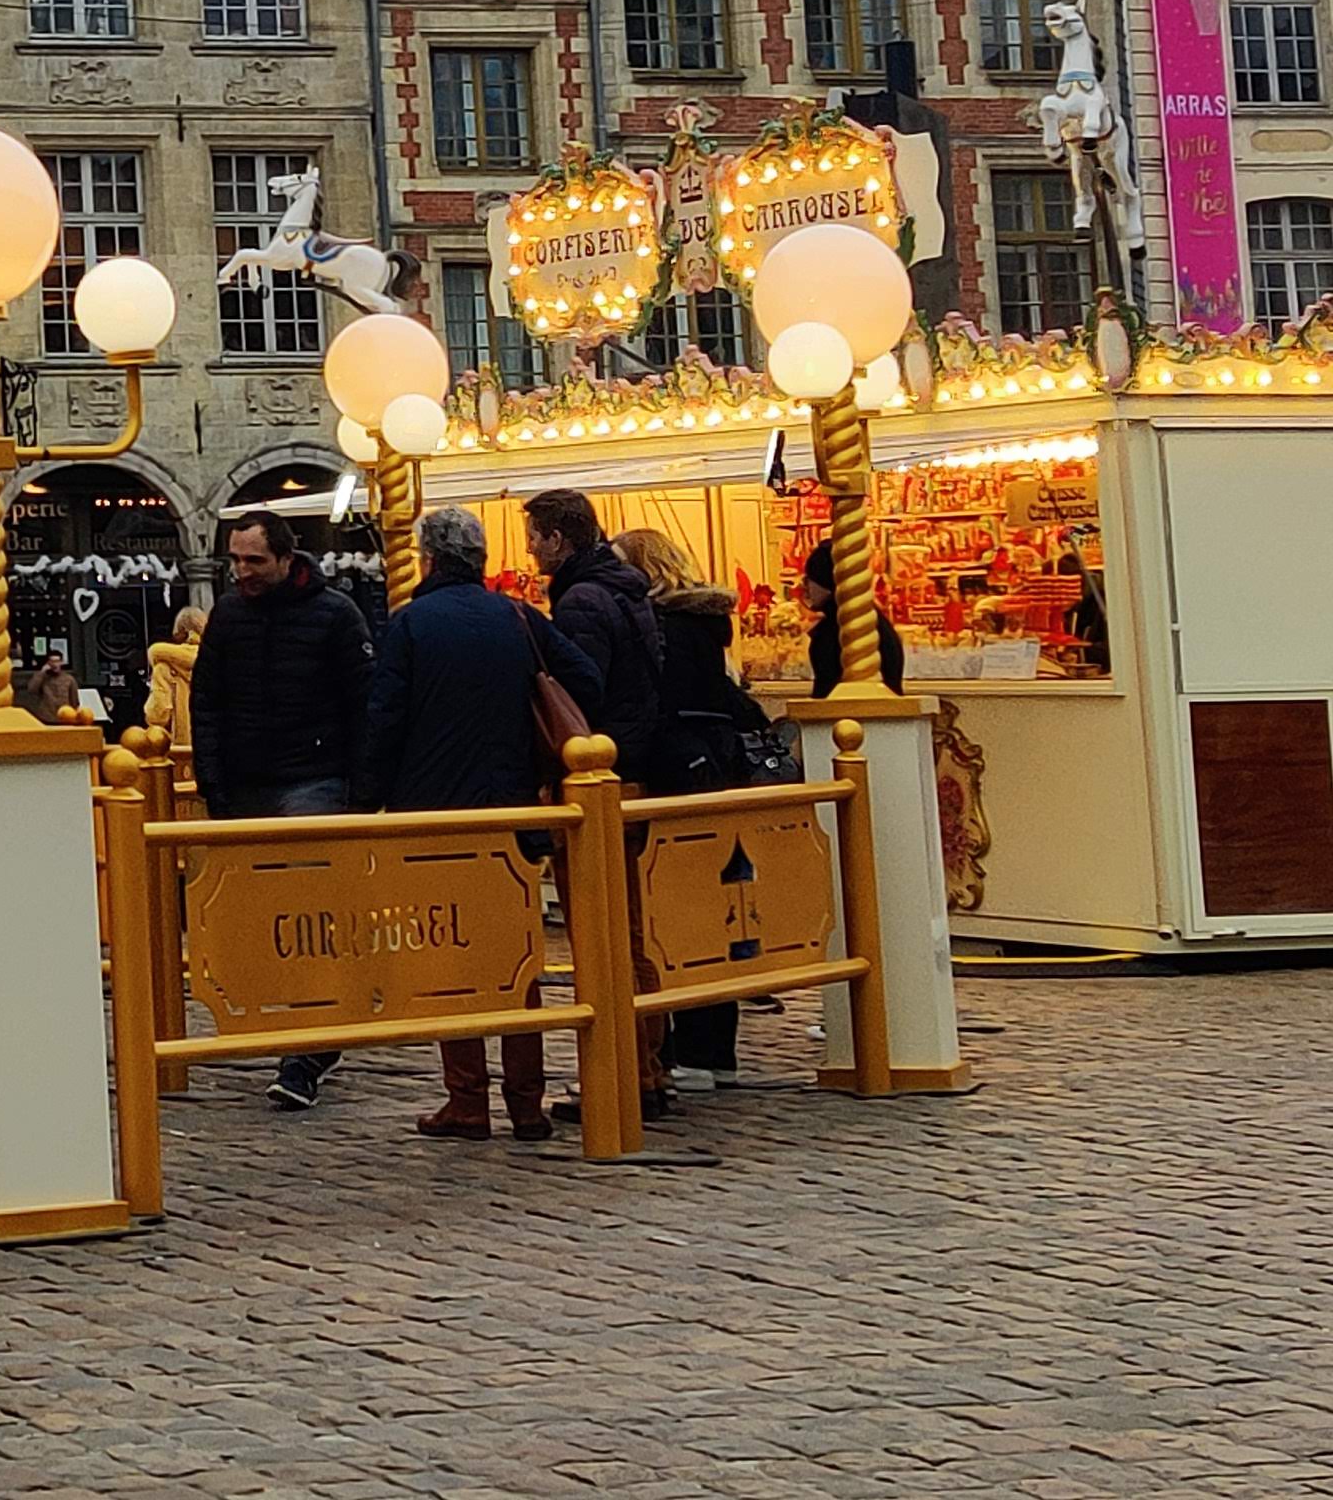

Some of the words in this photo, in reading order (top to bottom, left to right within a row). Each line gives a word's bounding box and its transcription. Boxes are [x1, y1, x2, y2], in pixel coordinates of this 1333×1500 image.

[1165, 94, 1226, 117] ARRAS
[523, 224, 649, 267] CONFISERIE
[741, 189, 885, 232] CARROUSEL
